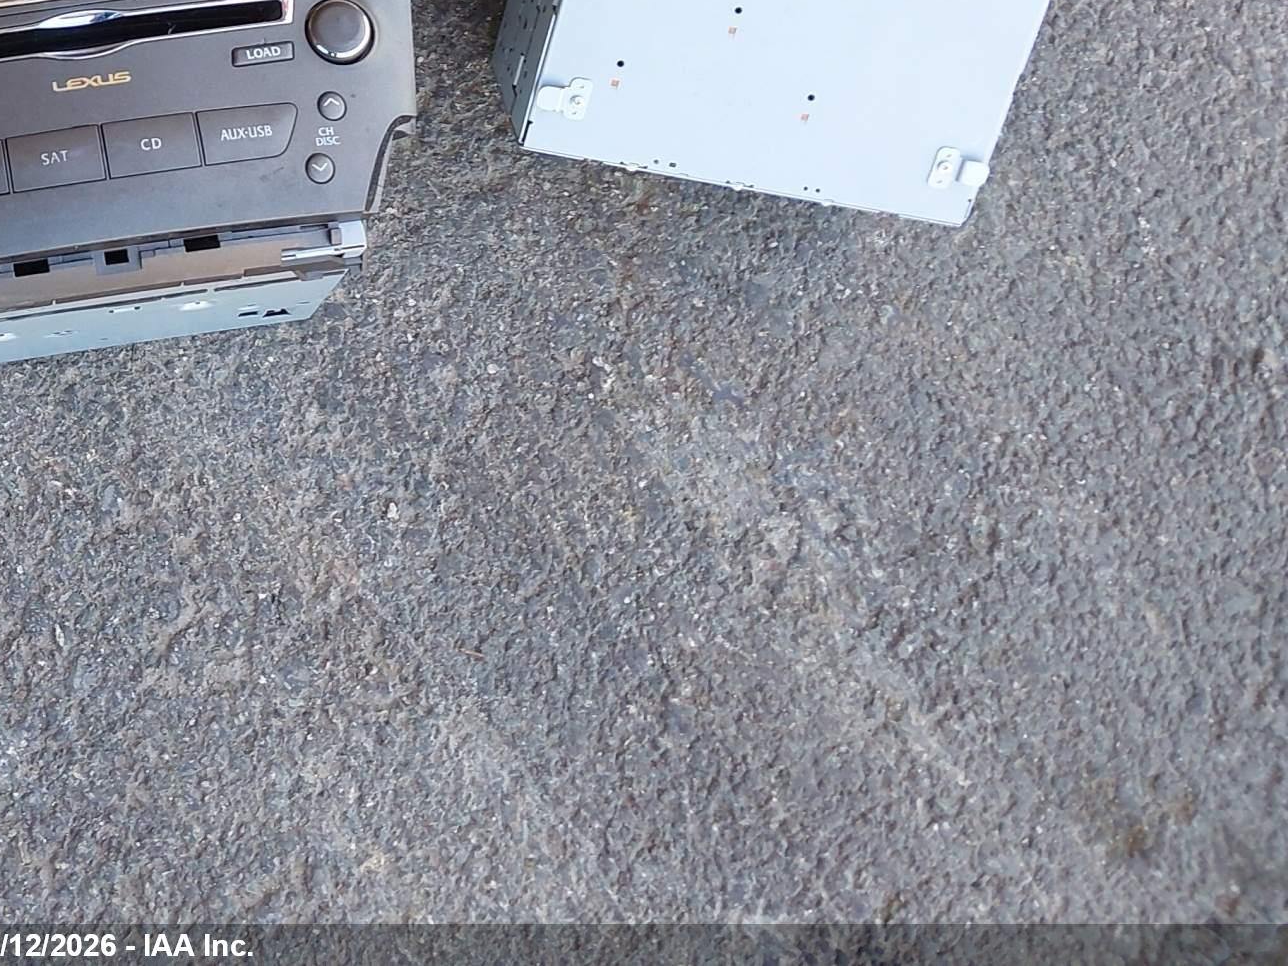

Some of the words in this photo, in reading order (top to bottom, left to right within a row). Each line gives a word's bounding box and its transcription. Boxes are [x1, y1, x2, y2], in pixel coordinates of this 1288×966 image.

[246, 45, 281, 60] LOAD
[52, 71, 132, 92] LEXUS
[318, 126, 335, 136] CH
[140, 137, 162, 151] CD
[315, 136, 341, 146] DISC
[40, 149, 68, 166] SAT
